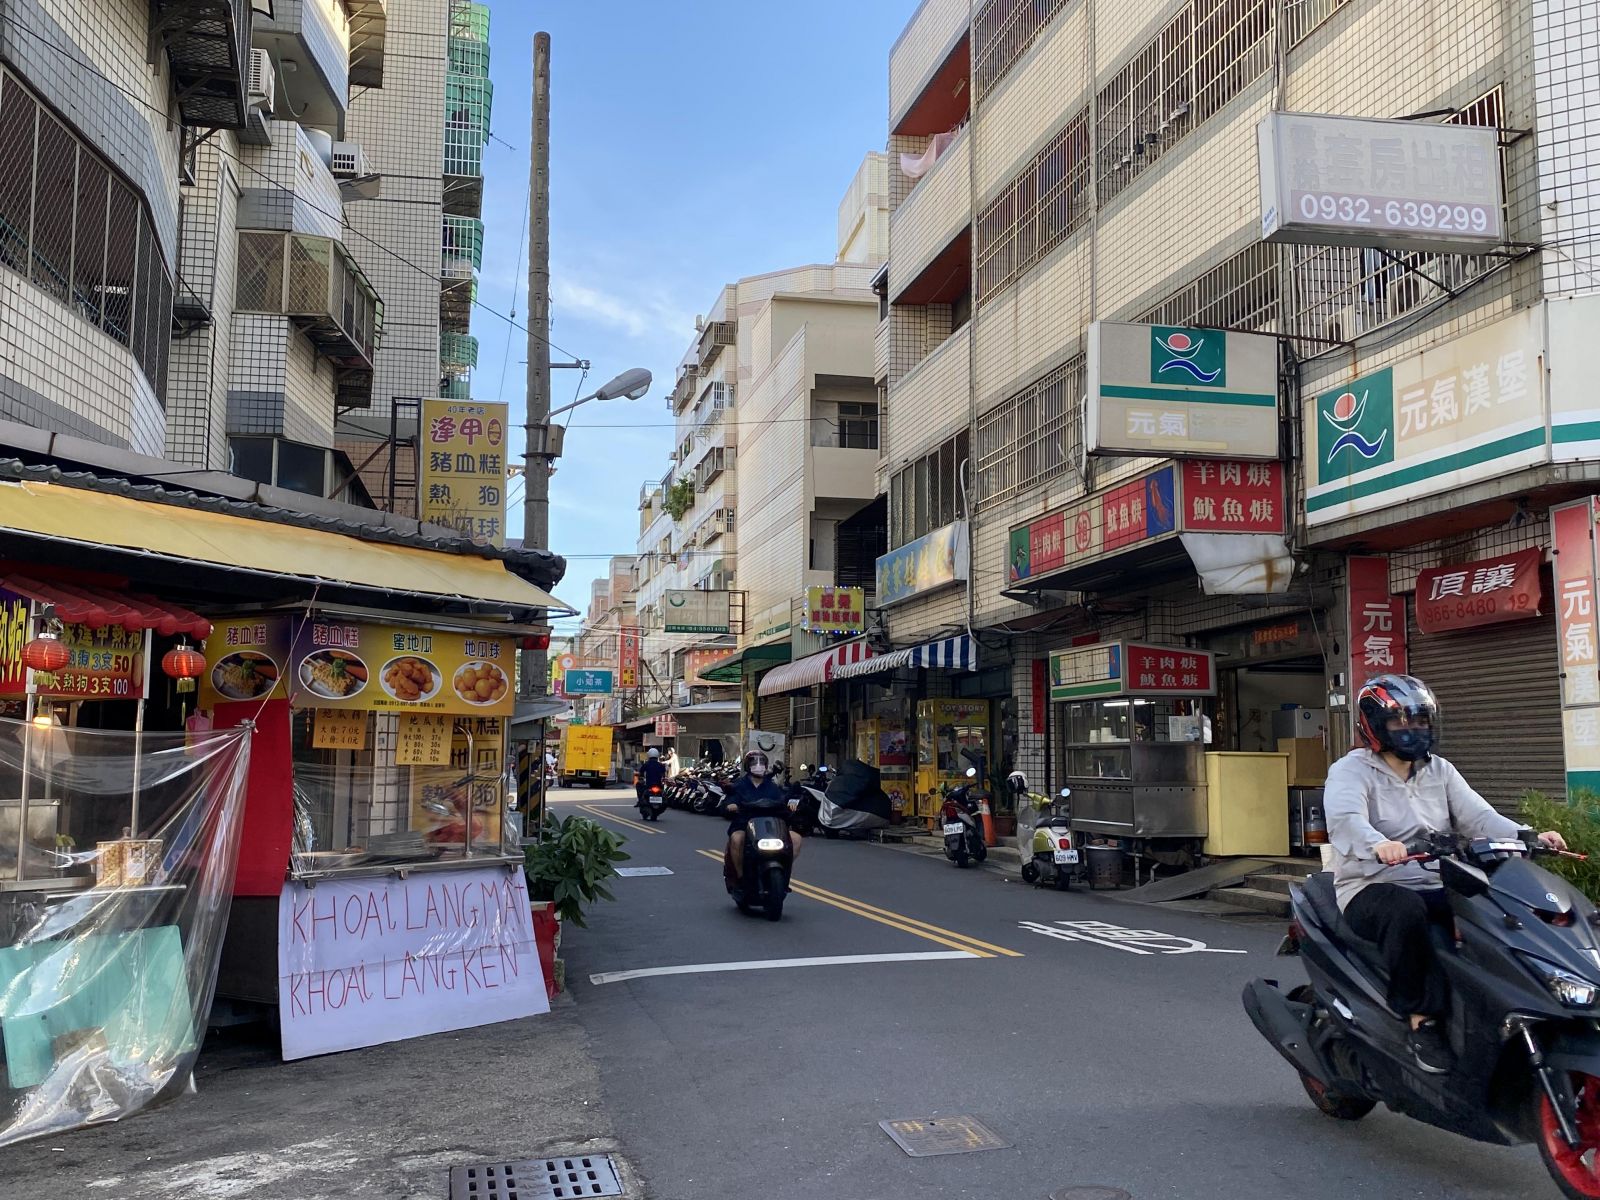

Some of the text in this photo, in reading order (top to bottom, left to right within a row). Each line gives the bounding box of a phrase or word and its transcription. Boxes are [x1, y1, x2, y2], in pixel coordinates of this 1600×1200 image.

[1300, 193, 1487, 232] 0932-639299
[1400, 350, 1528, 436] 元氣漢堡
[430, 416, 483, 446] 逢甲
[430, 451, 501, 475] 豬血糕
[429, 483, 500, 506] 熱狗
[1428, 563, 1517, 600] 頂讓
[226, 624, 267, 646] 豬血糕
[312, 624, 359, 648] 豬血糕
[392, 632, 433, 653] 蜜地瓜
[464, 640, 501, 659] 地瓜球
[405, 882, 479, 930] LANG
[384, 950, 456, 1000] LANG
[462, 943, 519, 995] KEN
